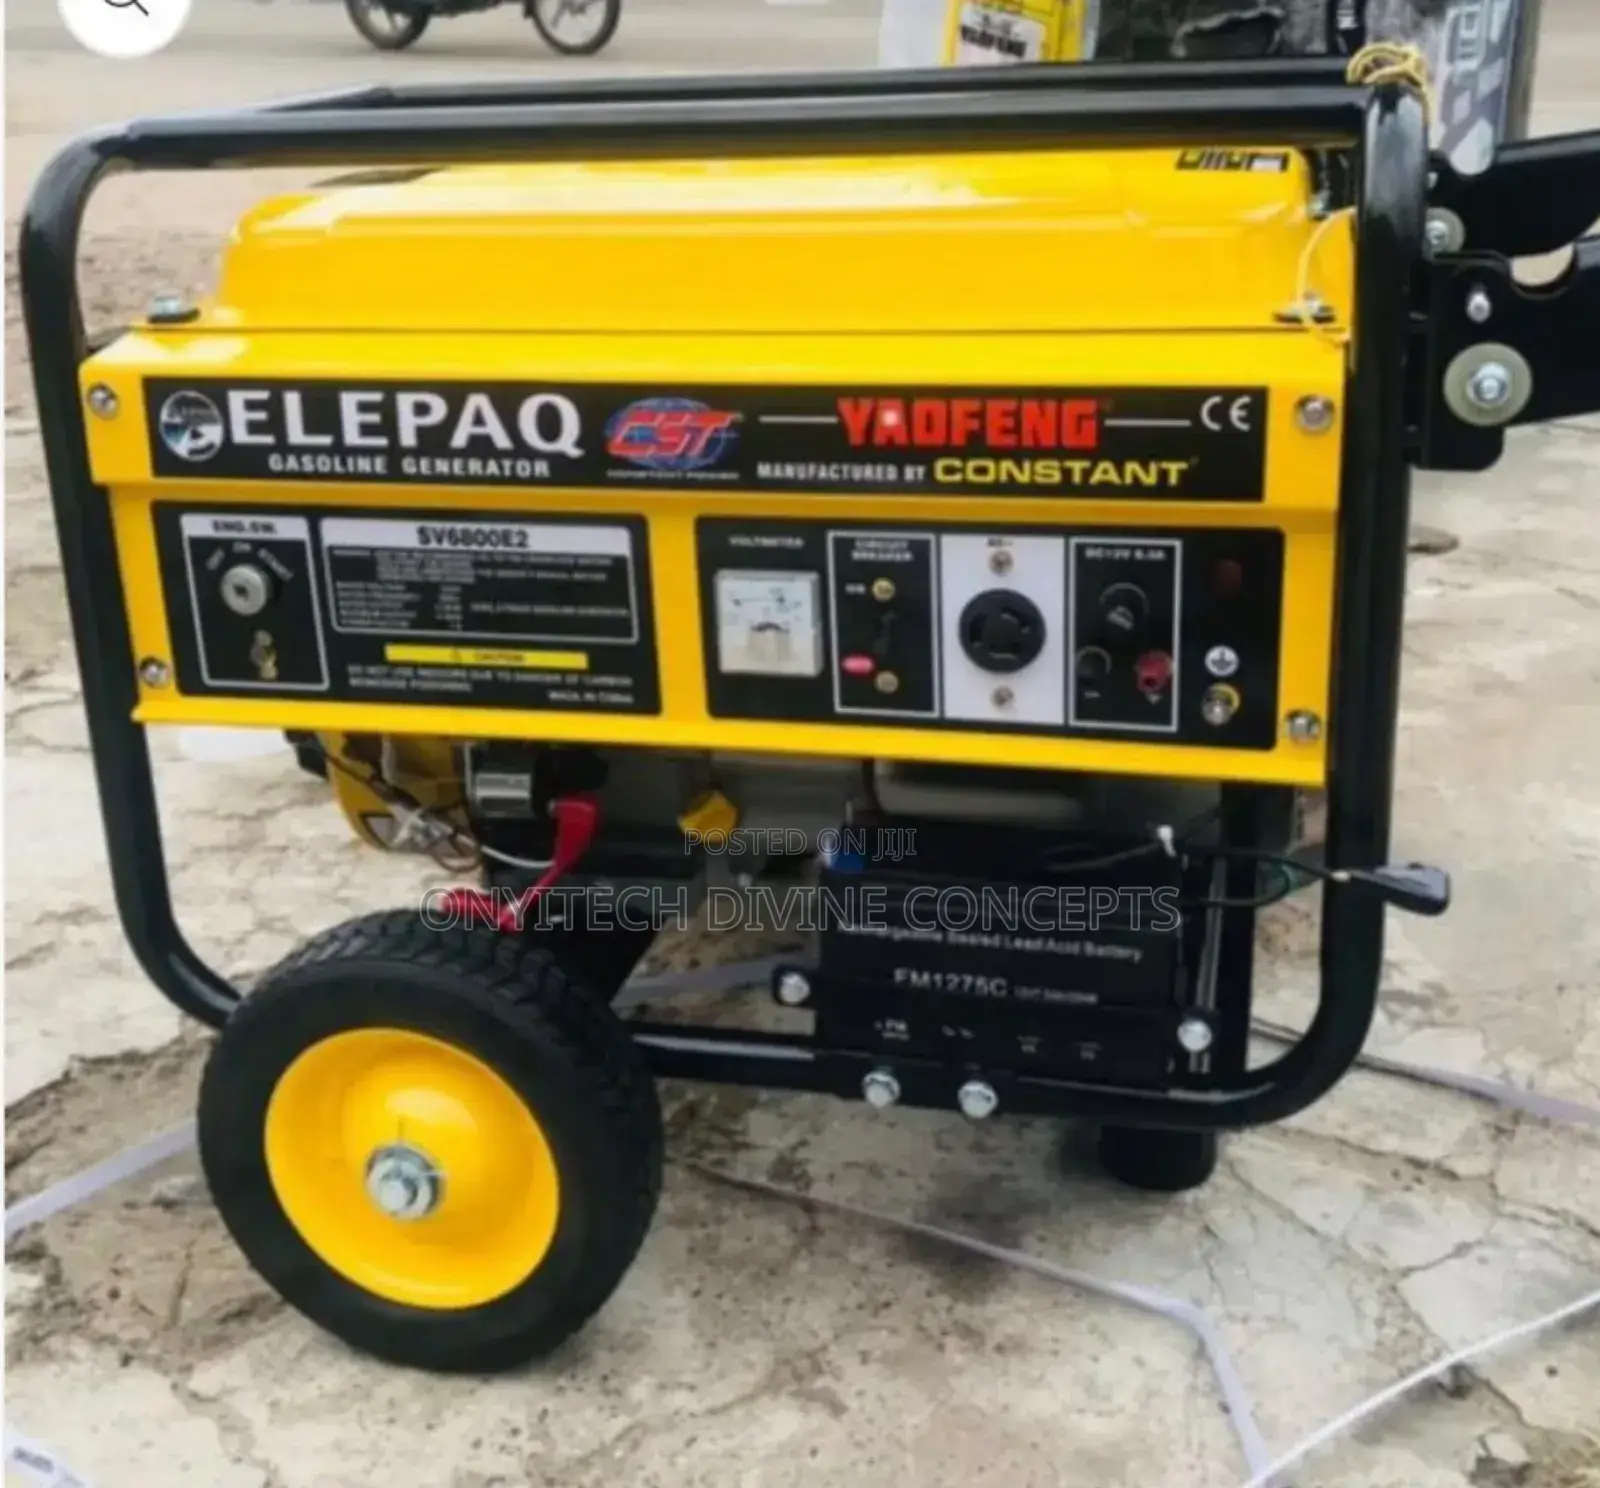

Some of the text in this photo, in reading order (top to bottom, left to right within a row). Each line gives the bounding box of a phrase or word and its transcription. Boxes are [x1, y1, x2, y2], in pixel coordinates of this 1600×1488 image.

[226, 390, 585, 458] ELEPAQ
[837, 398, 1099, 449] YAOFENG
[1201, 396, 1251, 431] CE
[607, 410, 744, 459] CST
[268, 453, 551, 479] GASOLINE GENERATOR
[757, 462, 897, 482] MANUFACTURED
[904, 465, 926, 482] BY
[934, 457, 1190, 486] CONSTANT
[416, 525, 530, 548] SV6800E2
